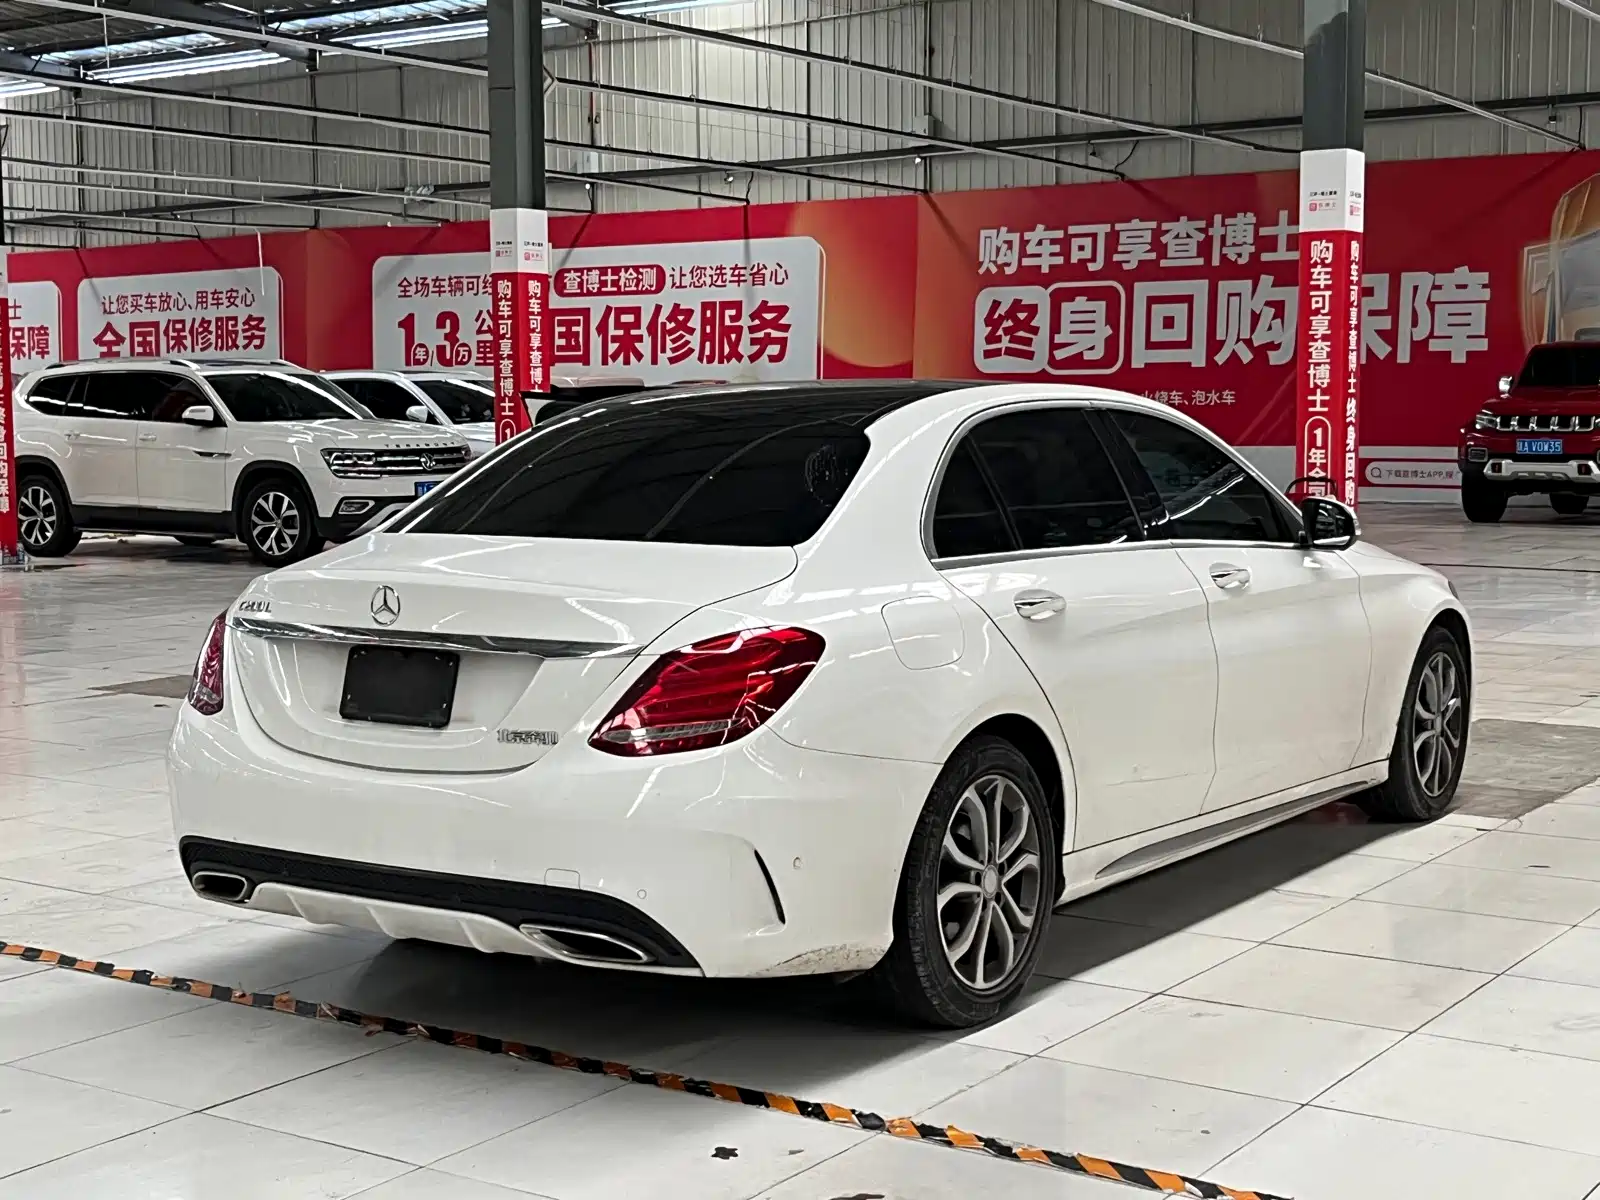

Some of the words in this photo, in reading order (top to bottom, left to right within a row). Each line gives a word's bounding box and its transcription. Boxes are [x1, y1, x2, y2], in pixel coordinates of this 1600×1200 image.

[977, 209, 1300, 275] 购车可享查博士
[563, 267, 657, 294] 查博士检测
[669, 262, 789, 290] 让您选车省心
[101, 287, 256, 316] 让您买车放心、用车安心
[92, 314, 268, 358] 全国保修服务
